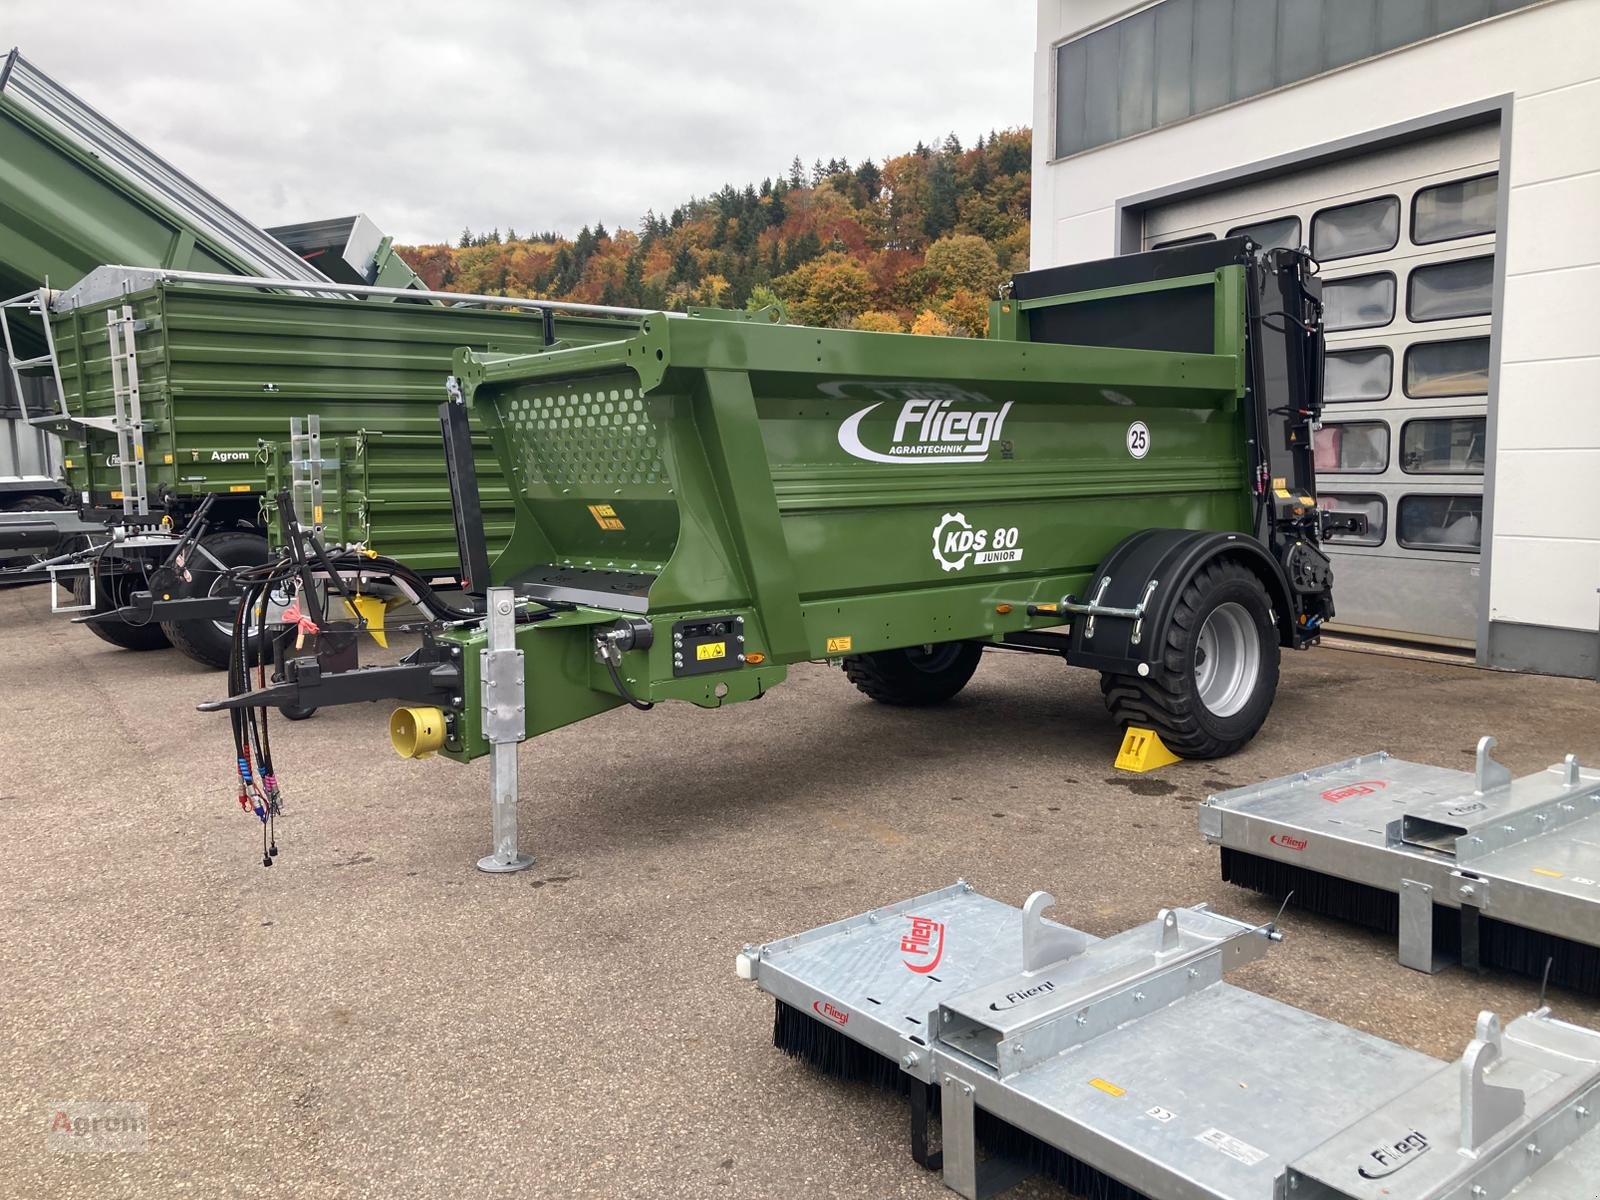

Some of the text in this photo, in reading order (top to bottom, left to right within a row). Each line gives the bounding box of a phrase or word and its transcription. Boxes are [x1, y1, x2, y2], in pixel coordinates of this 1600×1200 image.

[893, 400, 1014, 453] Fliegl
[1131, 430, 1146, 449] 25
[211, 451, 249, 462] Agrom
[889, 445, 963, 455] AGRARTECHNIK
[944, 527, 1019, 553] KDS 80
[982, 551, 1015, 562] JUNIOR
[1281, 835, 1307, 850] Fliegl
[900, 915, 939, 955] Fliegl
[824, 1002, 849, 1024] Fliegl
